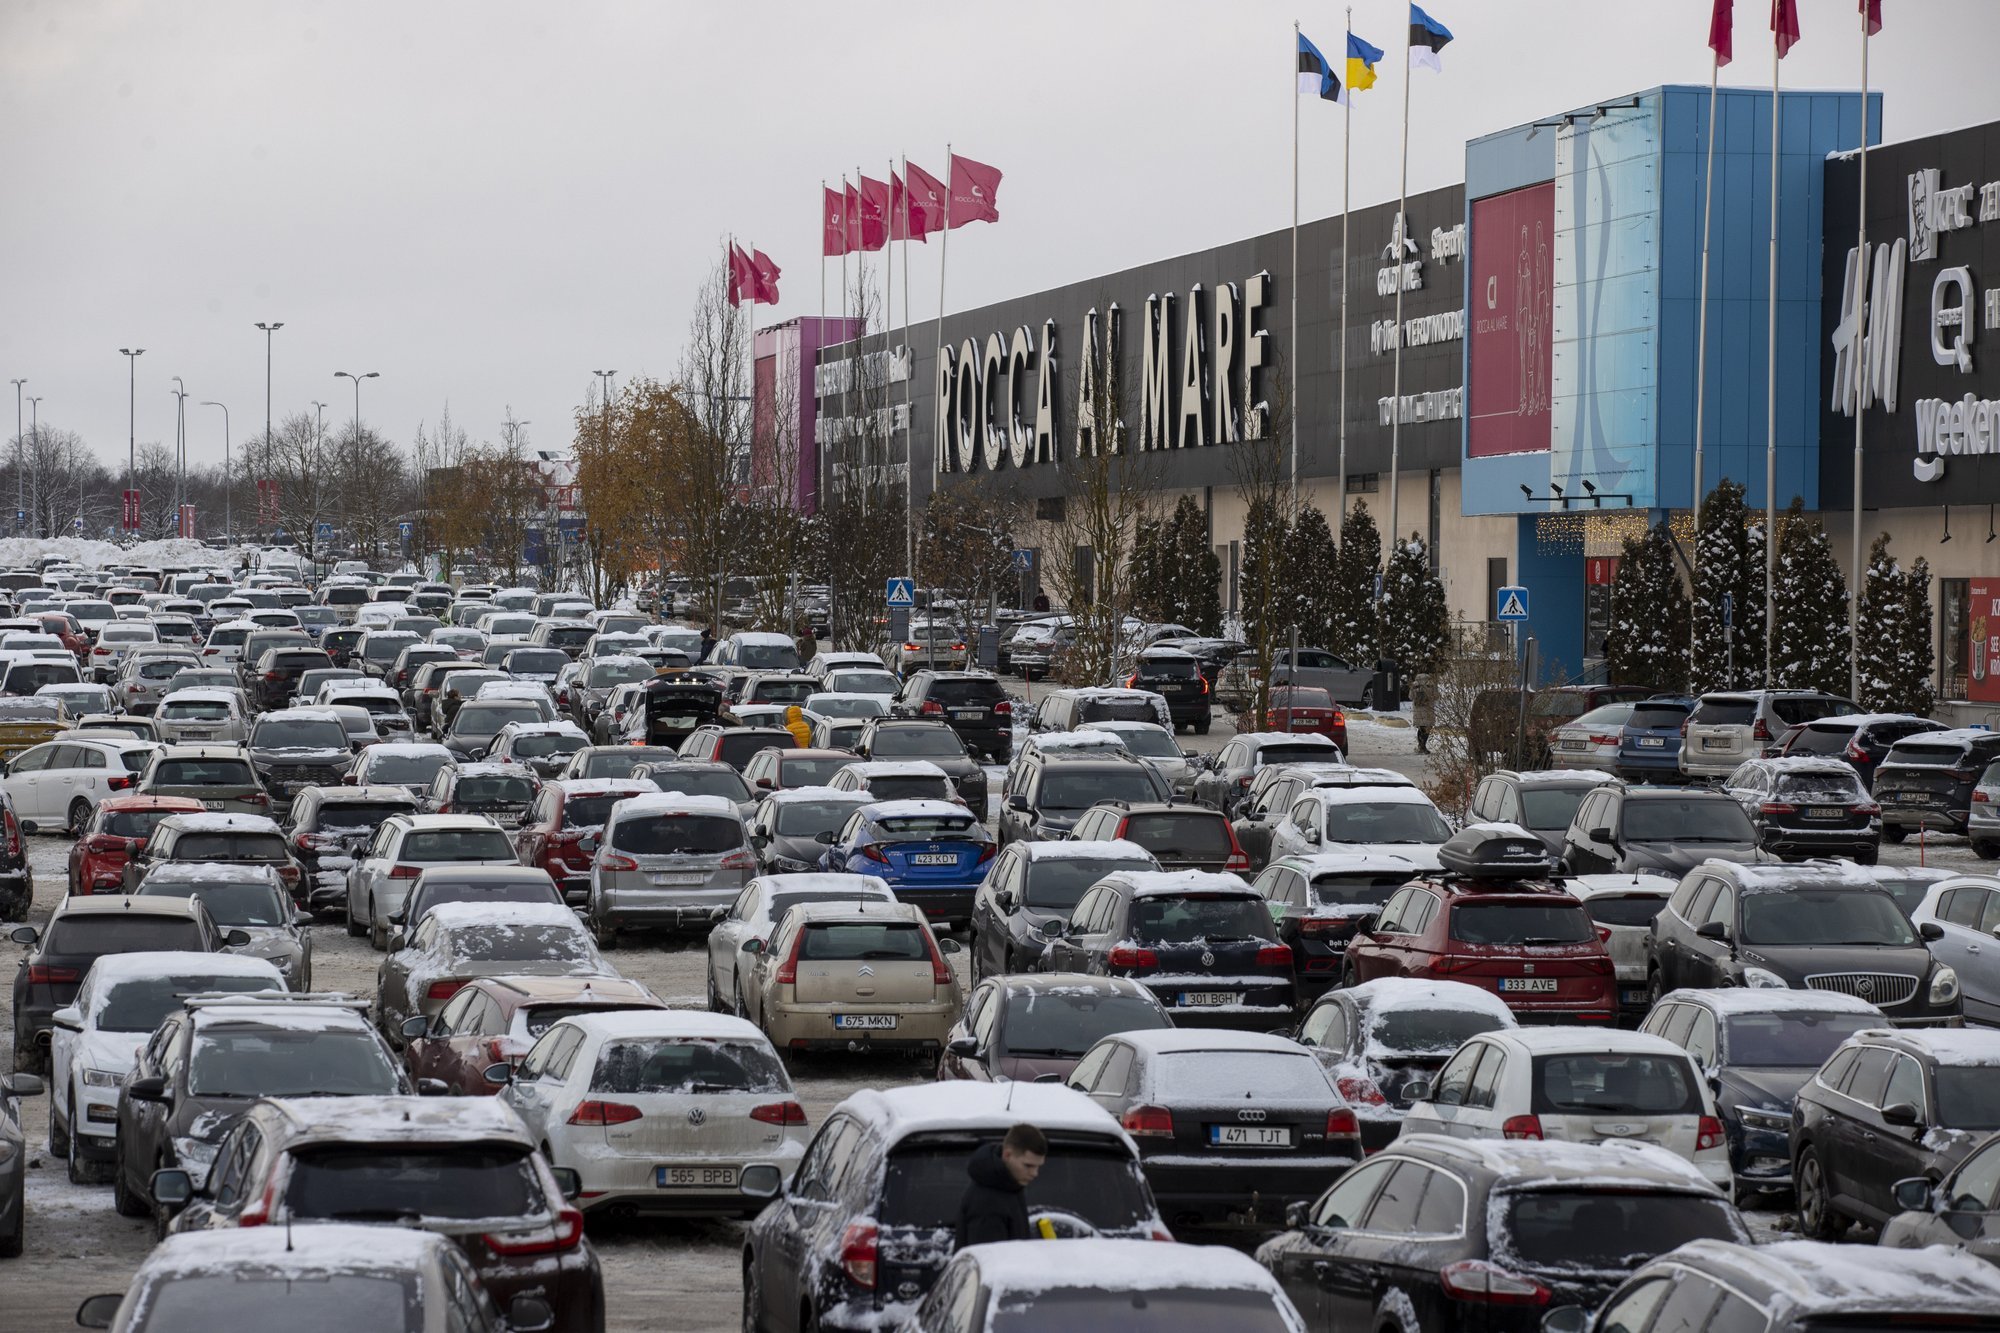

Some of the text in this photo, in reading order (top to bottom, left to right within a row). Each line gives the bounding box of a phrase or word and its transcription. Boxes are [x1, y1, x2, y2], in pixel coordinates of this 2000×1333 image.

[1932, 183, 1974, 232] KFC
[1405, 317, 1431, 347] VERO
[938, 318, 1059, 473] ROCCA
[1140, 268, 1272, 453] MARE
[1825, 808, 1841, 816] CSY
[917, 855, 955, 863] 423 KDY
[1507, 979, 1555, 990] 333 AVE
[1190, 994, 1233, 1003] 301 BGH
[845, 1016, 892, 1025] 675 MKN
[1226, 1129, 1281, 1143] 471 TJT
[671, 1170, 732, 1183] 565 BPB
